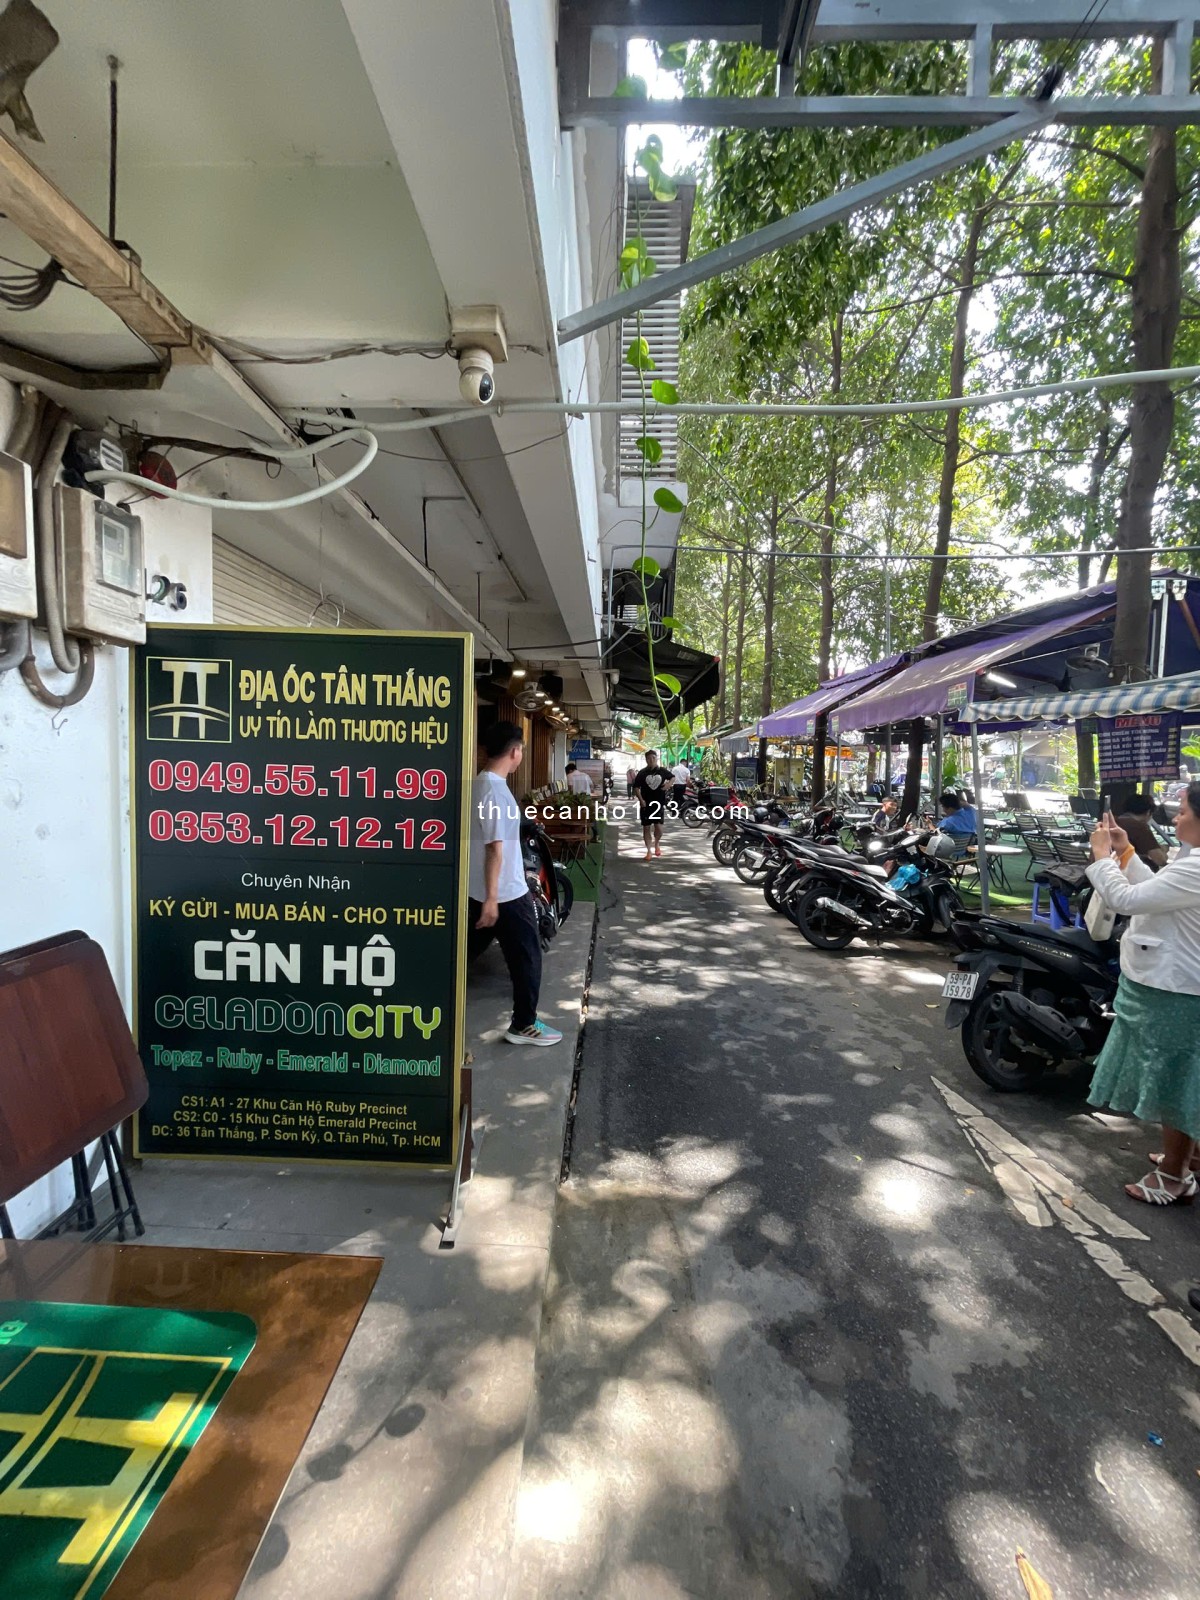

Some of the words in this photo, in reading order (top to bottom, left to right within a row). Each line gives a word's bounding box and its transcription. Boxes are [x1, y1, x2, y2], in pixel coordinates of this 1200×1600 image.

[239, 669, 278, 709] ĐỊA
[282, 663, 316, 703] ỐC
[321, 664, 367, 705] TÂN
[372, 667, 451, 708] THẮNG
[240, 715, 262, 738] UY
[411, 715, 448, 750] HIỆU
[148, 759, 447, 800] 0949.55.11.99
[148, 809, 447, 851] 0353.12.12.12
[241, 872, 302, 891] Chuyên
[308, 875, 351, 892] Nhận
[149, 896, 176, 917] KÝ
[181, 896, 217, 918] GỬI
[235, 902, 279, 920] MUA
[284, 901, 326, 922] BÁN
[343, 906, 387, 924] CHO
[393, 905, 446, 926] THUÊ
[194, 928, 300, 984] CĂN
[322, 933, 396, 997] HỘ
[950, 973, 972, 984] 59-PA
[150, 1044, 203, 1071] Topaz
[216, 1046, 263, 1075] Ruby
[277, 1049, 349, 1073] Emerald
[363, 1052, 441, 1076] Diamond
[229, 1113, 243, 1124] 15
[245, 1113, 269, 1125] Khu
[272, 1114, 295, 1126] Căn
[298, 1115, 315, 1129] Hộ
[318, 1116, 366, 1129] Emerald
[369, 1117, 417, 1131] Precinct
[236, 1097, 250, 1109] 27
[253, 1098, 277, 1110] Khu
[280, 1099, 303, 1111] Căn
[306, 1100, 323, 1114] Hộ
[325, 1101, 356, 1116] Ruby
[359, 1102, 408, 1115] Precinct
[151, 1125, 173, 1137] ĐC:
[176, 1126, 191, 1137] 36
[193, 1126, 215, 1138] Tân
[218, 1125, 258, 1142] Thắng,
[261, 1129, 271, 1140] P.
[274, 1130, 298, 1141] Sơn
[362, 1133, 388, 1146] Phú,
[391, 1134, 410, 1147] Tp.
[413, 1135, 441, 1147] HCM
